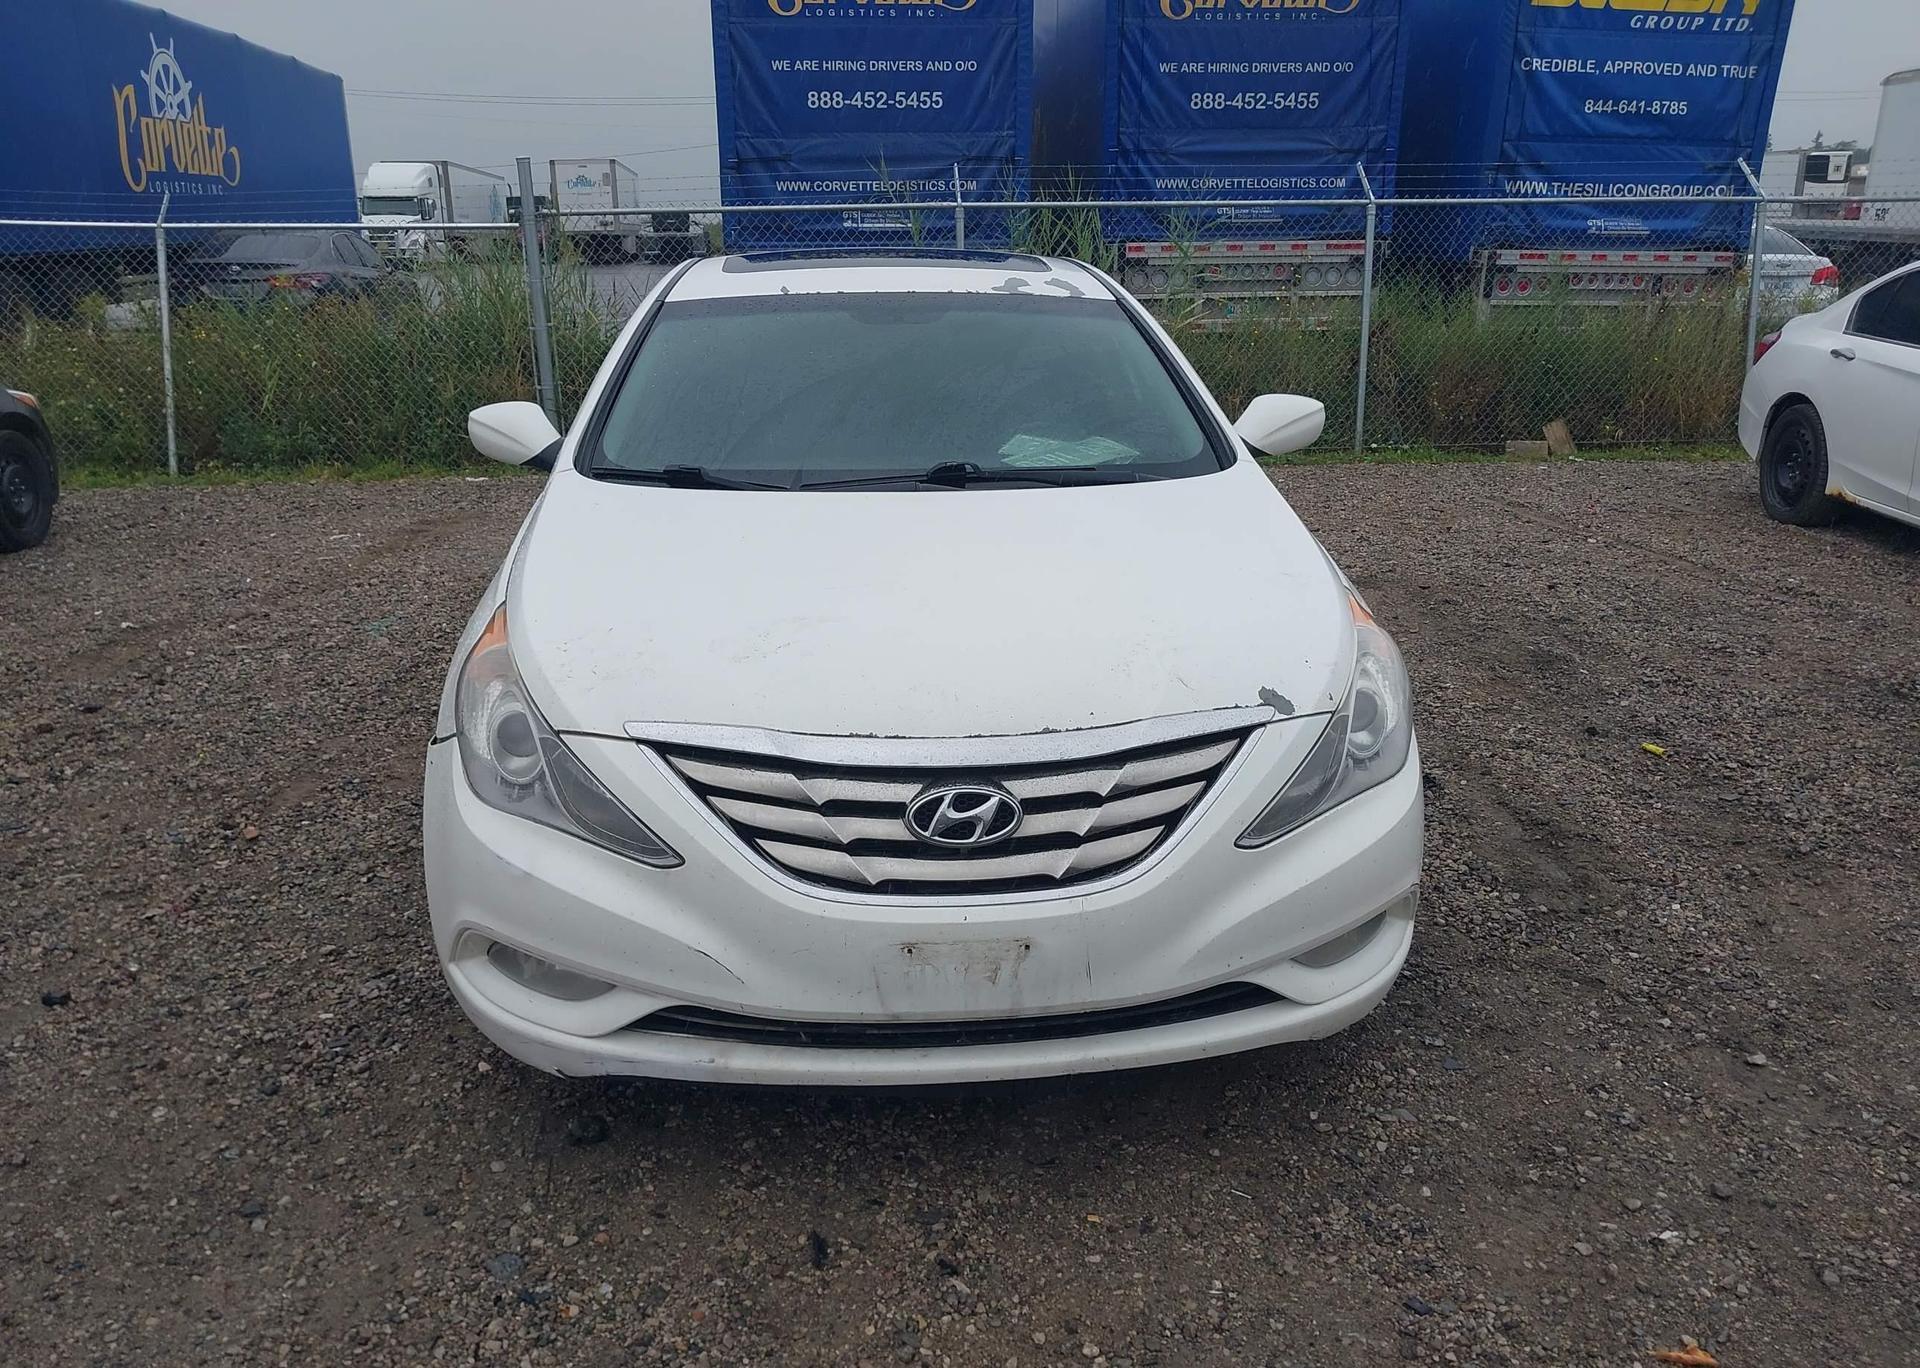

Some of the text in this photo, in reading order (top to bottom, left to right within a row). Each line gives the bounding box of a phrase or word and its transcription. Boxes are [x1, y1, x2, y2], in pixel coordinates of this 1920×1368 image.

[805, 8, 944, 17] LOGISTICS INC.
[1195, 12, 1326, 21] LOGISTICS INC.
[1630, 14, 1754, 32] GROUP LTD.
[771, 60, 978, 72] WE ARE HIRING DRIVERS AND O/O
[1159, 61, 1354, 73] WE ARE HIRING DRIVERS AND O/O
[1520, 57, 1758, 79] CREDIBLE, APPROVED AND TRUE
[807, 91, 943, 109] 888-452-5455
[1190, 92, 1320, 110] 888-452-5455
[1584, 99, 1688, 115] 844-641-8785
[112, 83, 241, 193] Corvette
[148, 180, 204, 194] LOGISTICS
[776, 180, 977, 192] WWW.CORVETTELOGISTICS.COM
[1155, 178, 1346, 190] WWW.CORVETTELOGISTICS.COM
[1216, 207, 1232, 215] GTS
